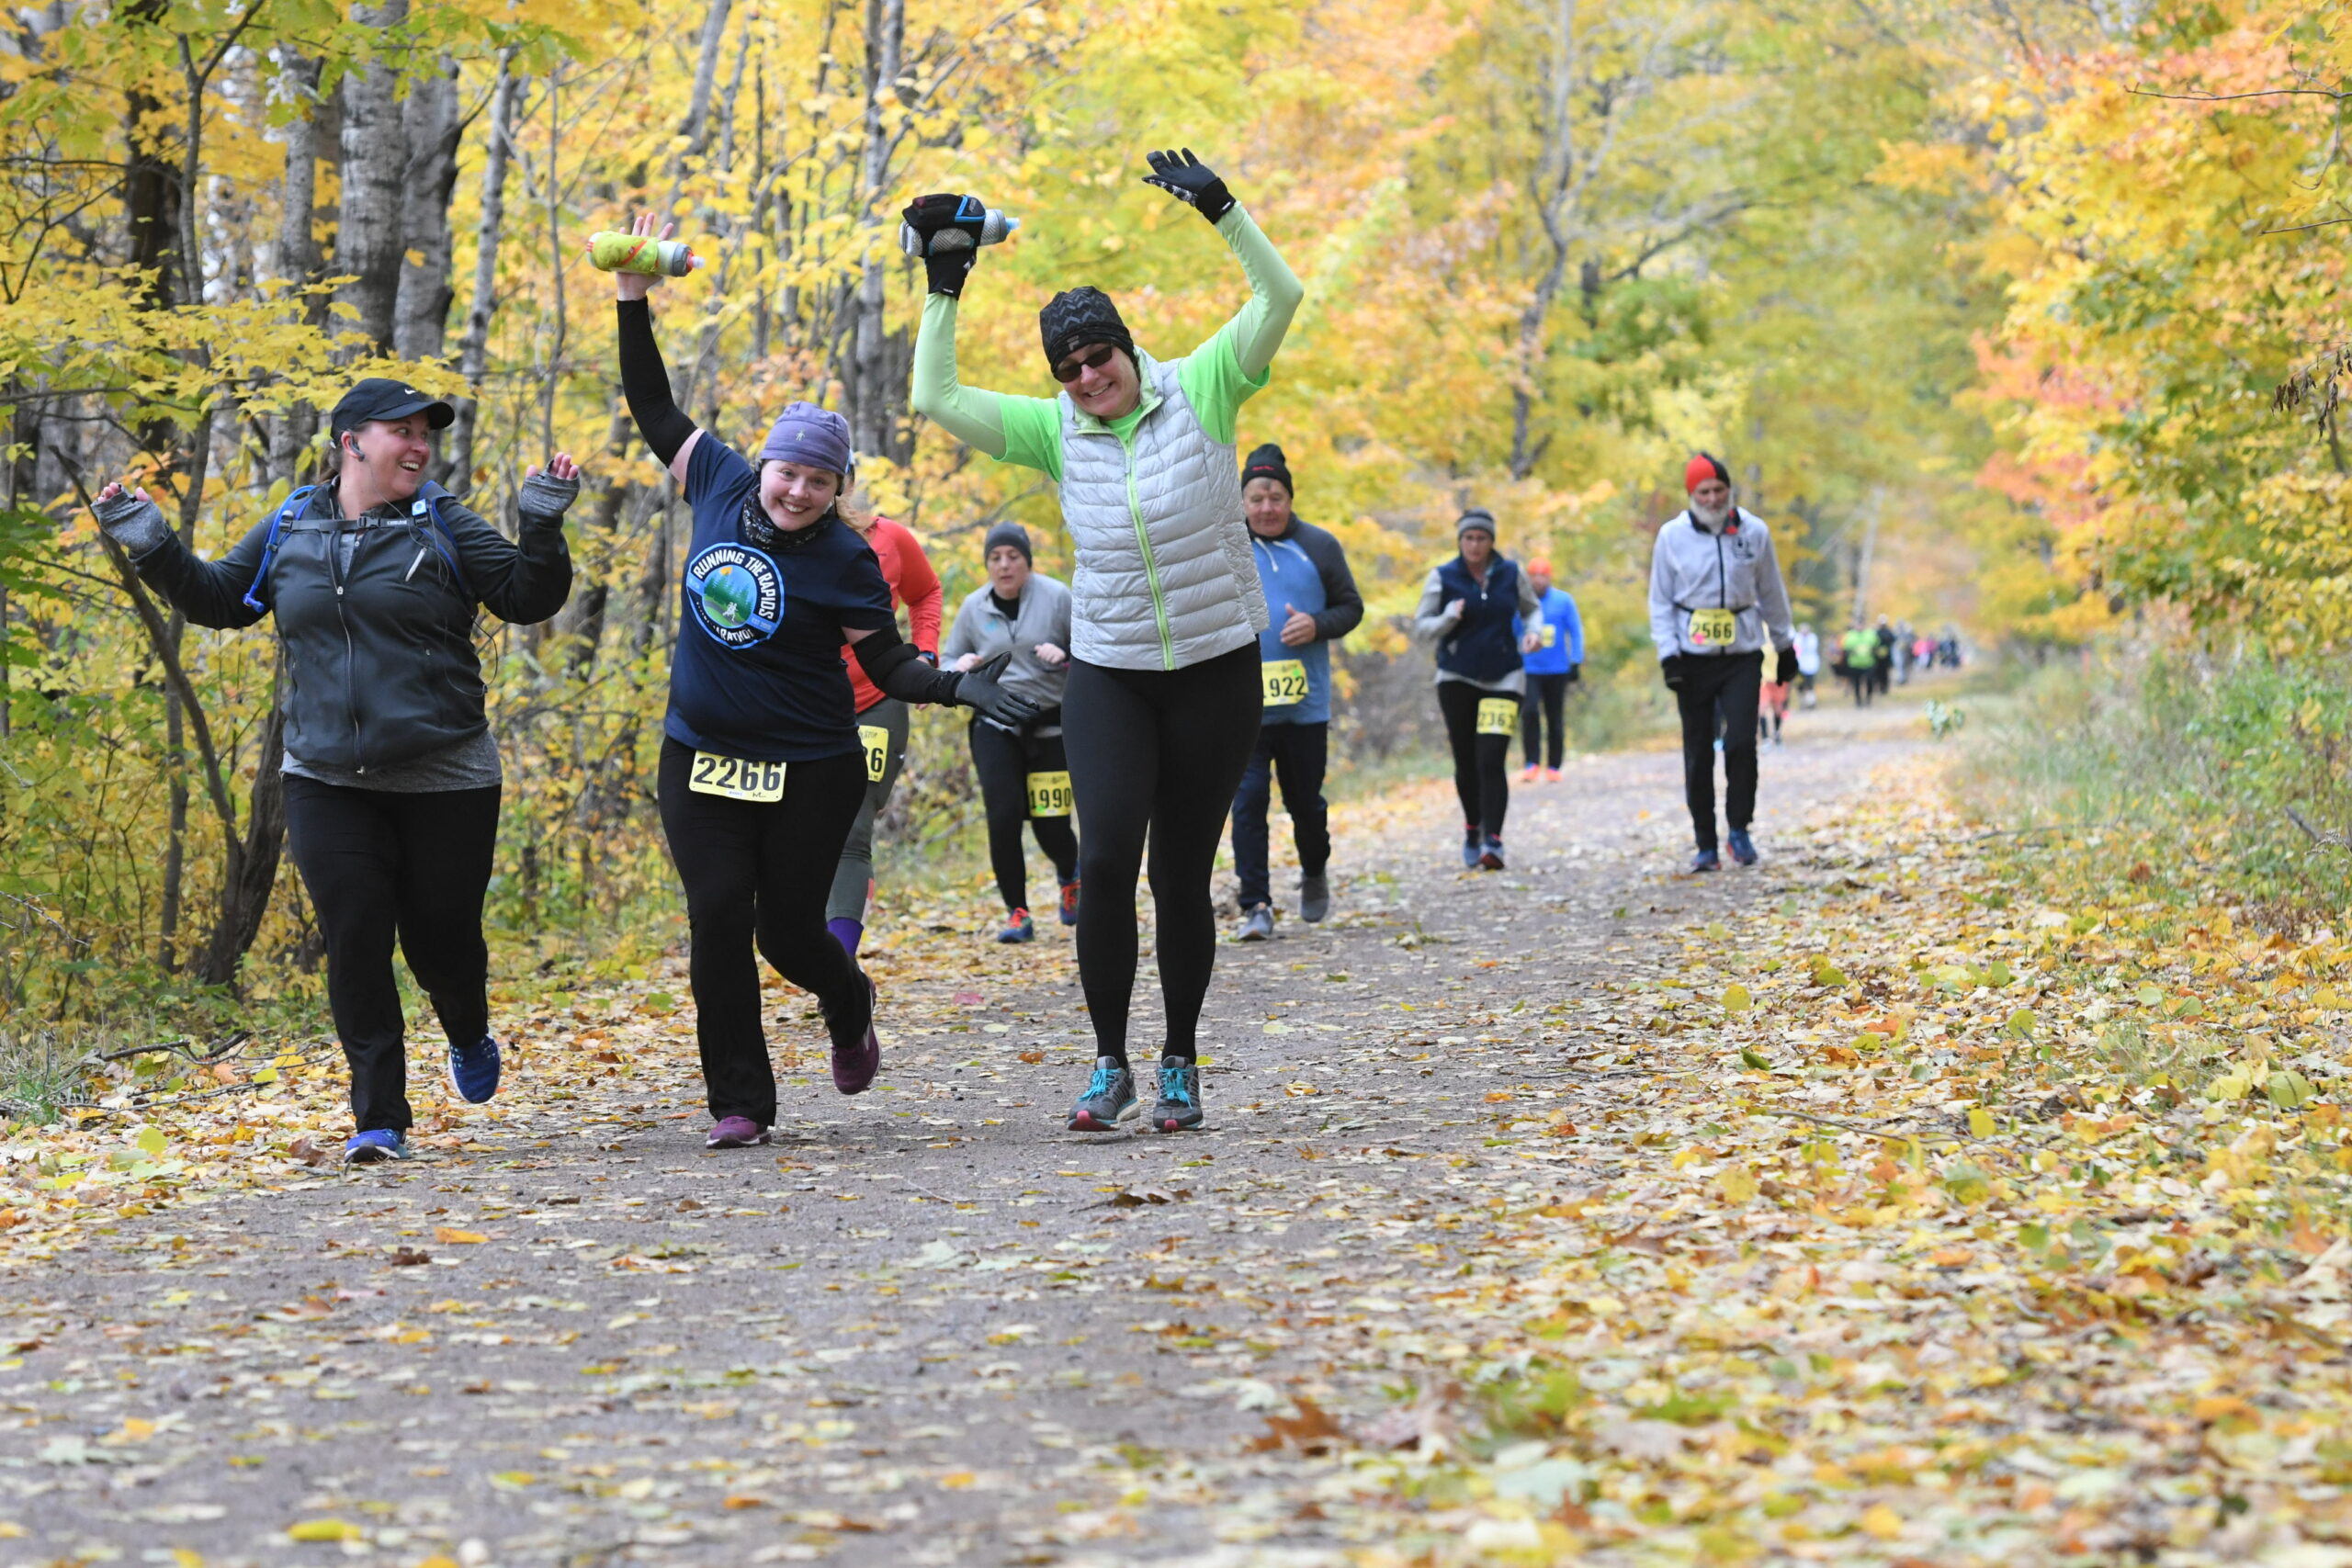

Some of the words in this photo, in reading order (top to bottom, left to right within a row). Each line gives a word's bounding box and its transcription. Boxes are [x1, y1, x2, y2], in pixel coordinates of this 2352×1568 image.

[693, 549, 745, 579] RUNNING
[744, 557, 767, 577] THE
[758, 572, 776, 620] RAPIDS
[713, 625, 754, 642] RATHO
[1692, 623, 1732, 638] 2566
[1264, 676, 1306, 697] 922
[694, 757, 781, 791] 2266
[1030, 787, 1071, 809] 1990
